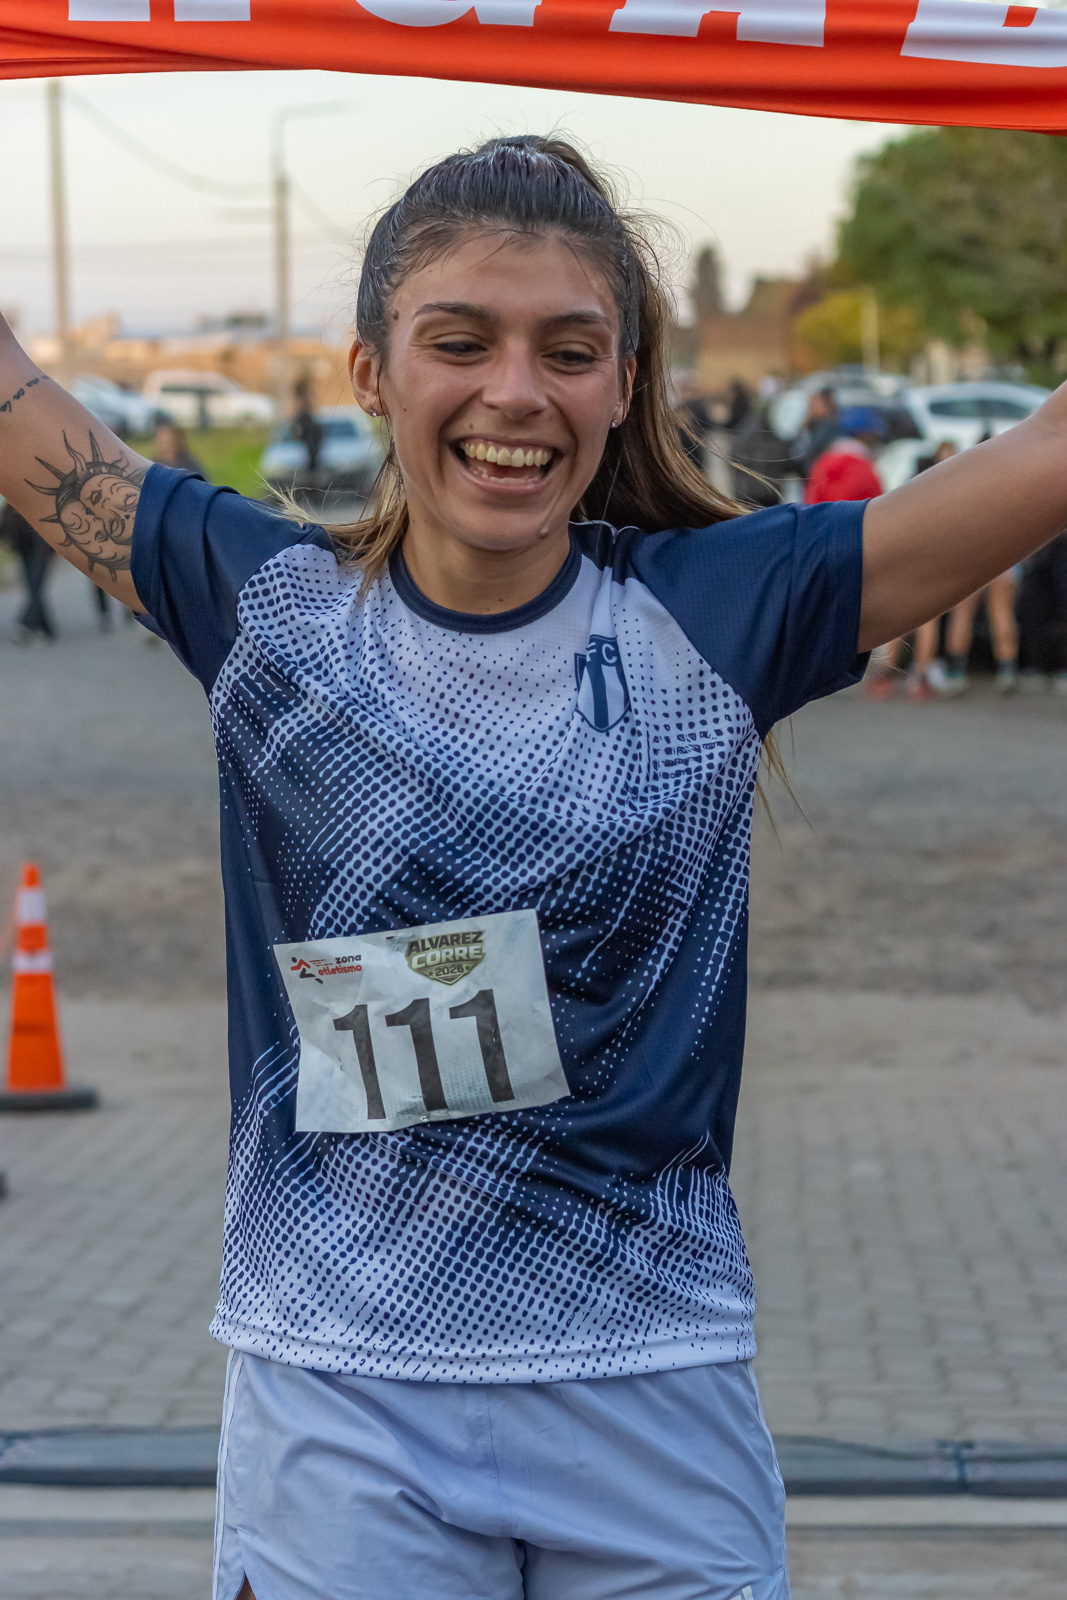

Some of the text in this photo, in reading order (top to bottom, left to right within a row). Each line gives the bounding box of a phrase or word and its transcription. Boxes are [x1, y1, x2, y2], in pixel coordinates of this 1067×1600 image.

[407, 931, 482, 957] ALVAREZ
[335, 954, 362, 964] zona
[411, 945, 482, 969] CORRE
[318, 964, 362, 976] atletismo
[435, 965, 464, 977] 2026
[333, 988, 515, 1120] 111
